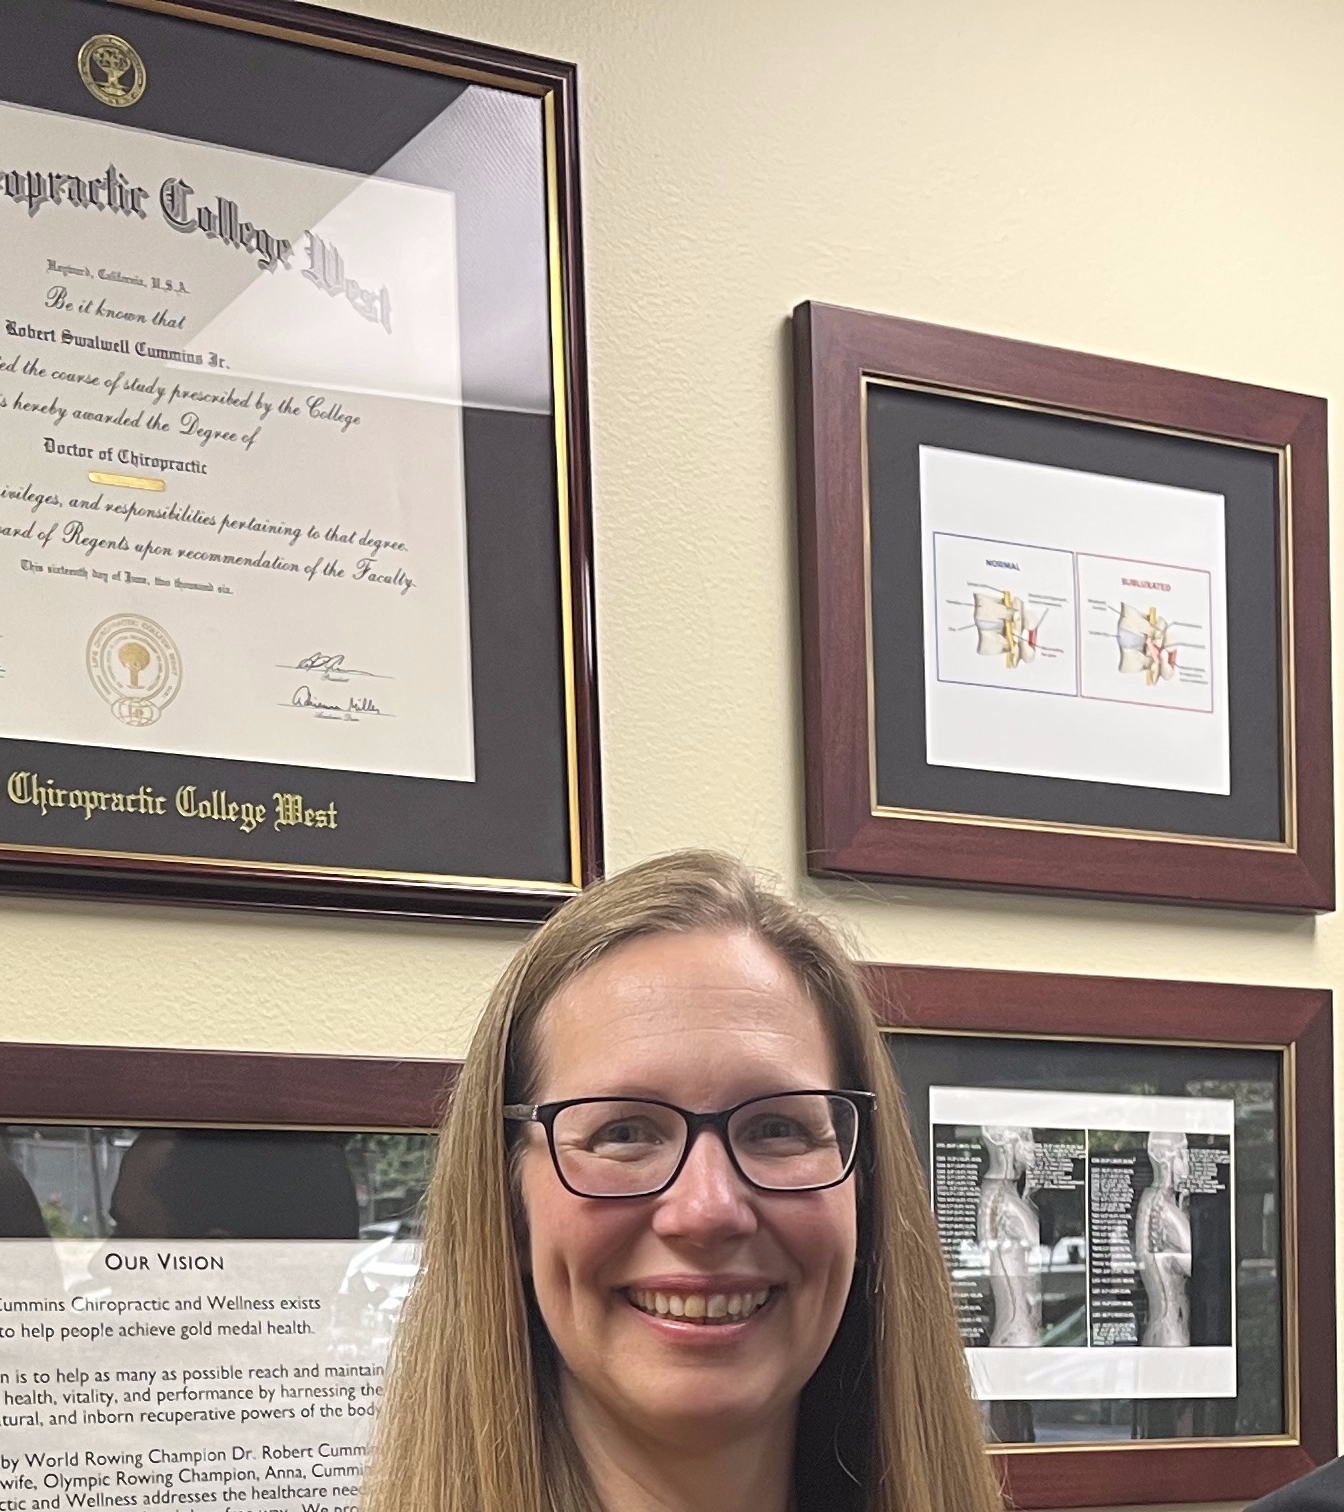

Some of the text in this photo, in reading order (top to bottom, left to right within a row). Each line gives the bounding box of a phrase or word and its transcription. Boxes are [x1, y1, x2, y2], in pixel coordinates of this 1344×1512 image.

[159, 176, 295, 274] College
[45, 286, 187, 330] Be it known that
[5, 319, 230, 370] Robert Swalwell Cummins Jr.
[23, 358, 47, 378] the
[51, 371, 100, 386] course
[104, 371, 126, 396] of
[123, 377, 166, 406] study
[168, 384, 254, 408] prescribed
[255, 392, 273, 421] by
[278, 397, 301, 416] the
[306, 395, 361, 433] College
[13, 392, 68, 427] hereby
[72, 408, 145, 428] awarded
[146, 413, 170, 432] the
[179, 412, 237, 448] Degree
[241, 426, 262, 452] of
[43, 437, 208, 475] Doctor of Chiropractic
[69, 493, 104, 511] and
[105, 502, 217, 526] responsibilities
[217, 514, 302, 547] pertaining
[307, 525, 321, 540] to
[324, 525, 358, 544] that
[359, 529, 408, 558] degree.
[37, 523, 59, 549] of
[62, 520, 131, 557] Regents
[134, 540, 173, 561] upon
[178, 549, 300, 573] recommendation
[304, 557, 324, 582] of
[323, 559, 345, 578] the
[352, 558, 417, 594] Faculty.
[7, 771, 168, 821] Chiropractic
[175, 785, 267, 834] College
[273, 793, 338, 832] West
[71, 1296, 171, 1316] Chiropractic
[175, 1296, 202, 1311] and
[207, 1296, 276, 1311] Wellness
[280, 1297, 322, 1310] exists
[21, 1323, 55, 1343] help
[61, 1322, 114, 1342] people
[119, 1321, 176, 1337] achieve
[180, 1320, 213, 1341] gold
[217, 1320, 262, 1336] medal
[267, 1320, 315, 1335] health.
[16, 1370, 28, 1385] is
[33, 1372, 51, 1384] to
[56, 1368, 90, 1388] help
[94, 1371, 111, 1383] as
[116, 1371, 157, 1386] many
[161, 1370, 178, 1382] as
[183, 1365, 243, 1386] possible
[248, 1364, 289, 1380] reach
[293, 1363, 320, 1378] and
[325, 1365, 384, 1378] maintain
[49, 1409, 78, 1426] and
[83, 1409, 134, 1424] inborn
[140, 1407, 236, 1426] recuperative
[241, 1408, 296, 1424] powers
[300, 1403, 316, 1418] of
[319, 1403, 343, 1418] the
[347, 1402, 381, 1417] bod
[0, 1474, 38, 1492] wife,
[43, 1473, 112, 1493] Olympic
[116, 1470, 174, 1489] Rowing
[178, 1467, 261, 1486] Champion,
[265, 1465, 307, 1480] Anna,
[311, 1463, 364, 1478] Cummi
[1, 1454, 20, 1474] by
[24, 1452, 79, 1468] World
[85, 1451, 144, 1470] Rowing
[148, 1449, 227, 1467] Champion
[232, 1446, 257, 1461] Dr.
[262, 1445, 314, 1460] Robert
[318, 1443, 367, 1458] Cumm
